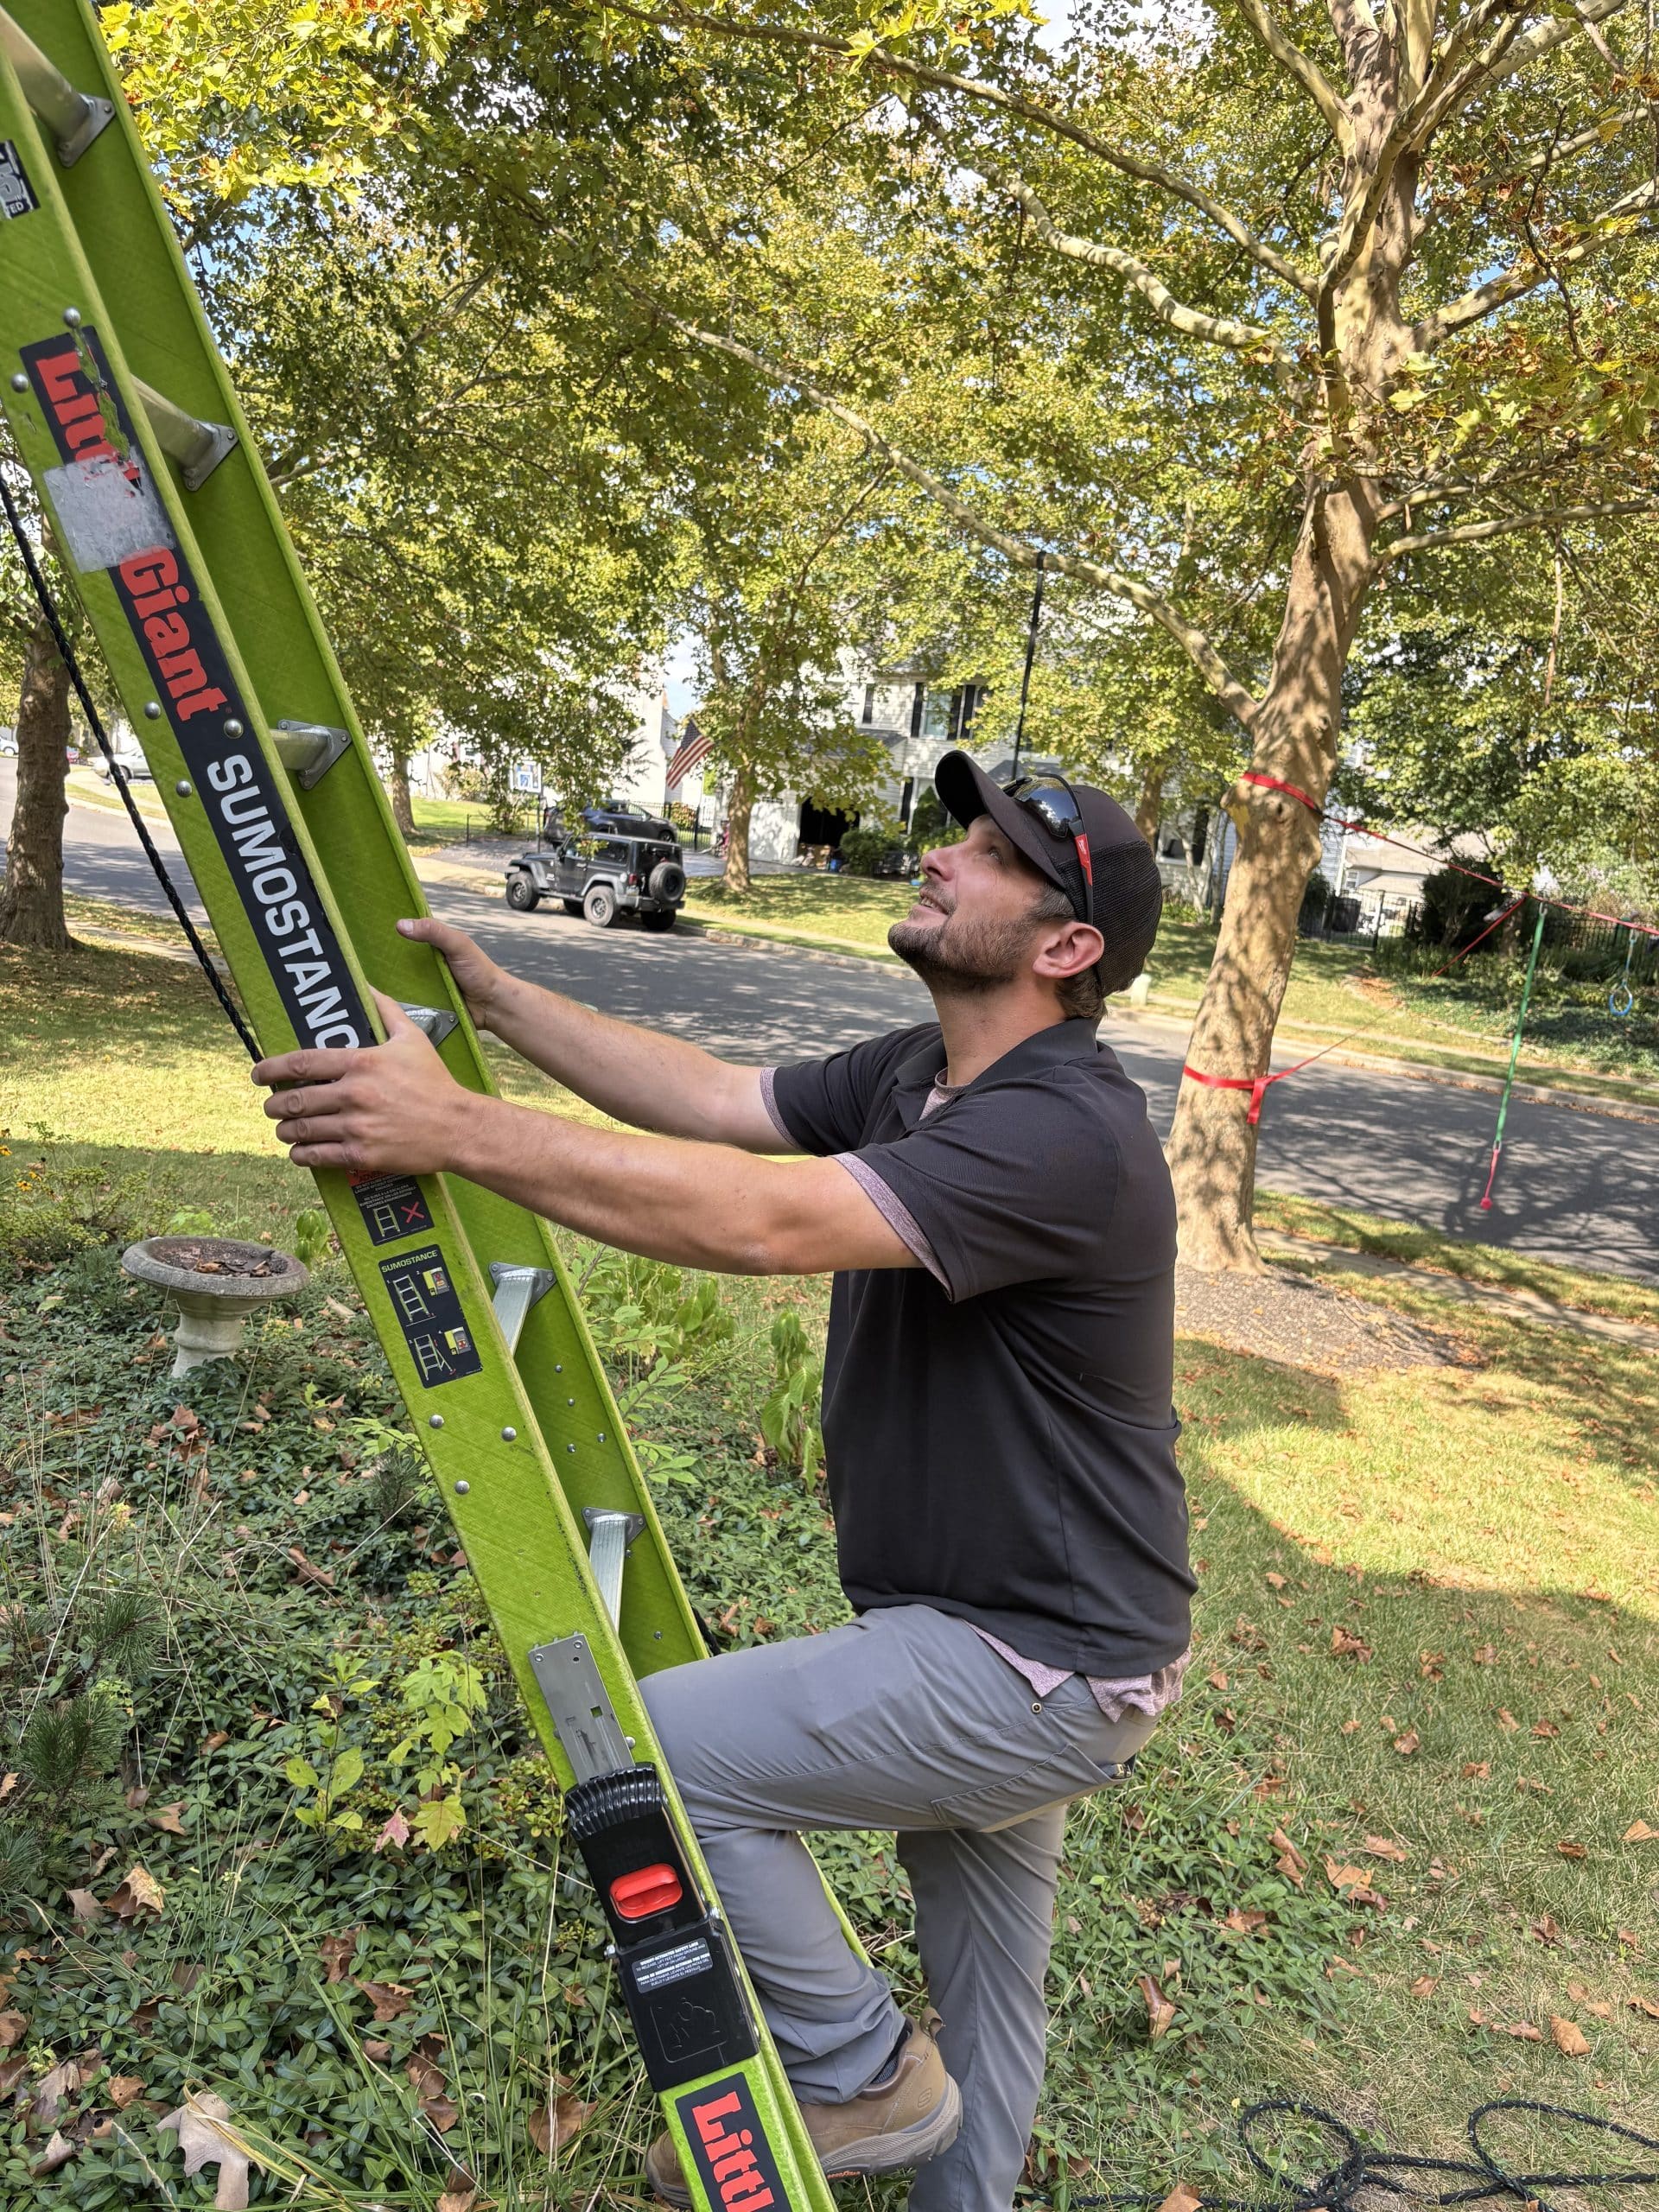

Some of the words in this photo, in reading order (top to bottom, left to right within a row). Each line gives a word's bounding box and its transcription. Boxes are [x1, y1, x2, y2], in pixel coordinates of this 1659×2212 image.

[119, 545, 228, 721] Giant
[207, 754, 360, 1050] SUMOSTANC
[381, 1250, 438, 1273] SUMOSTANCE
[692, 2091, 775, 2212] Littl
